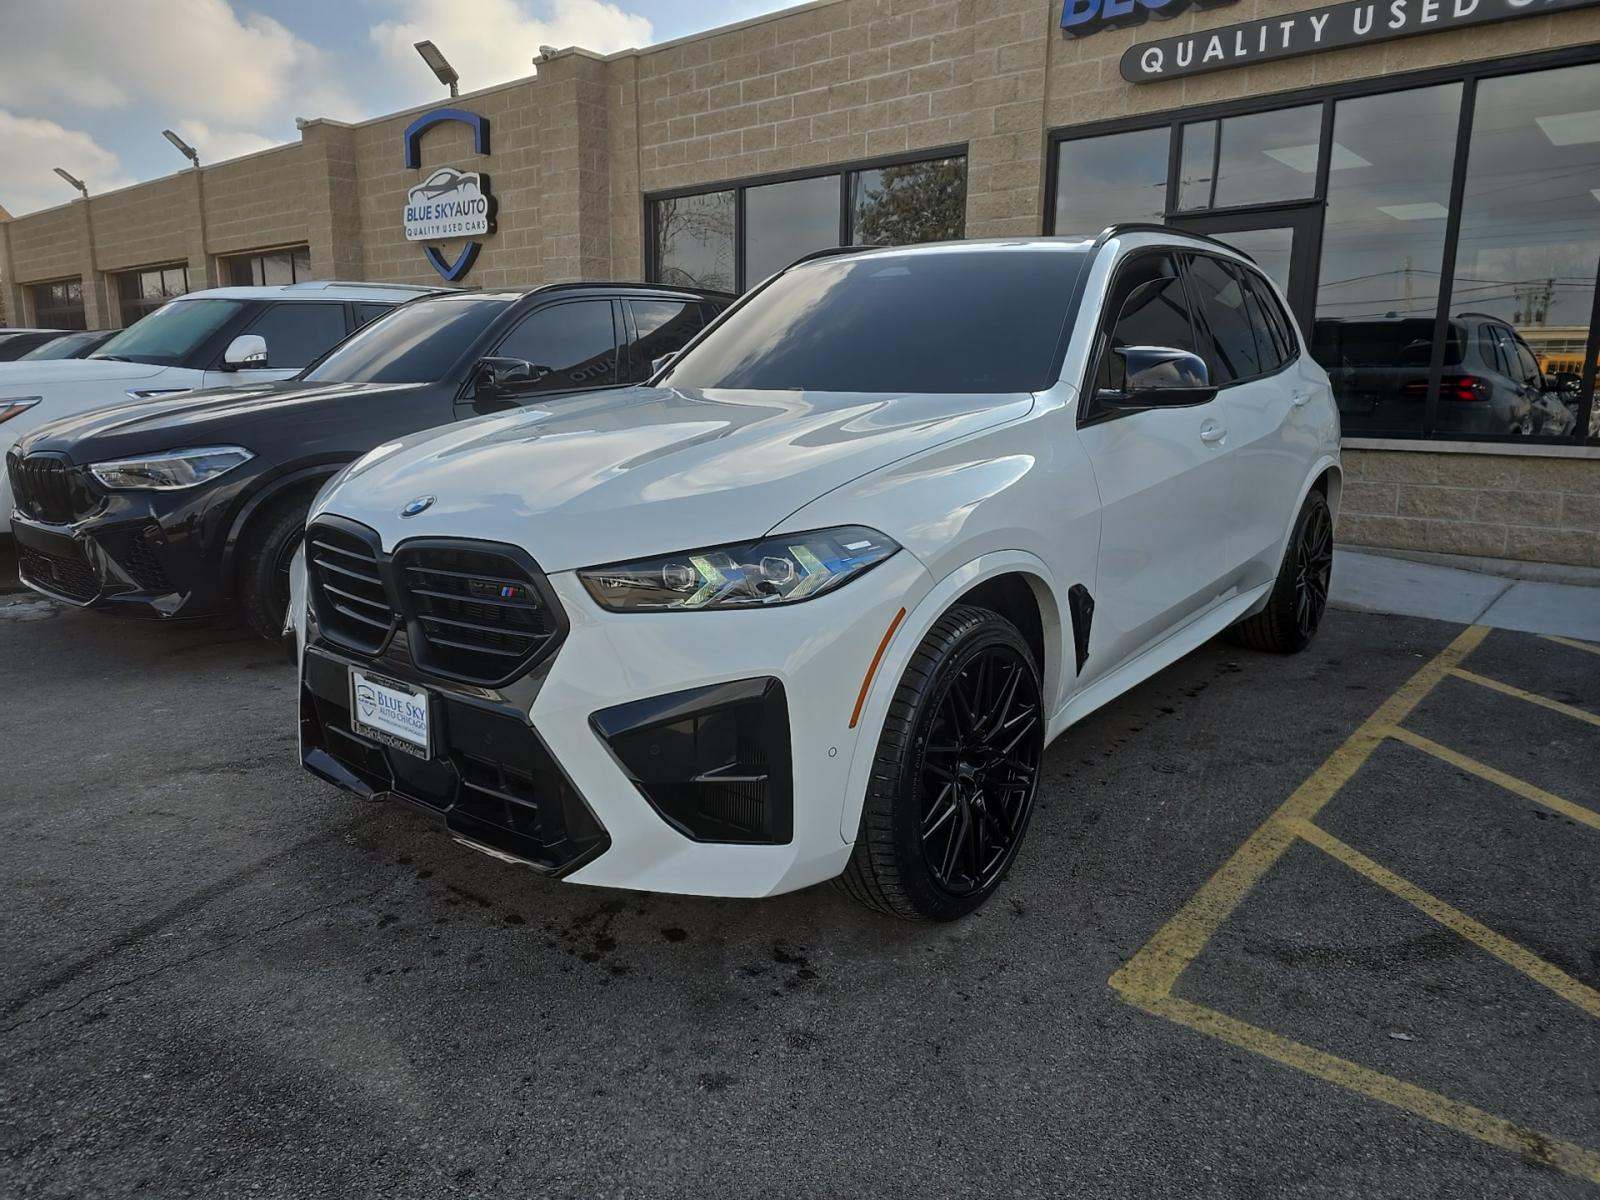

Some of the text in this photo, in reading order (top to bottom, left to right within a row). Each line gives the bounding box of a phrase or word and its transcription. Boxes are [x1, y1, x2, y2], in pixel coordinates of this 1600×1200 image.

[1140, 13, 1329, 73] QUALITY
[1353, 0, 1479, 35] USED
[407, 205, 431, 221] BLUE
[407, 220, 486, 236] QUALITY USED CARS
[377, 691, 403, 712] BLUE
[406, 701, 425, 720] SKY
